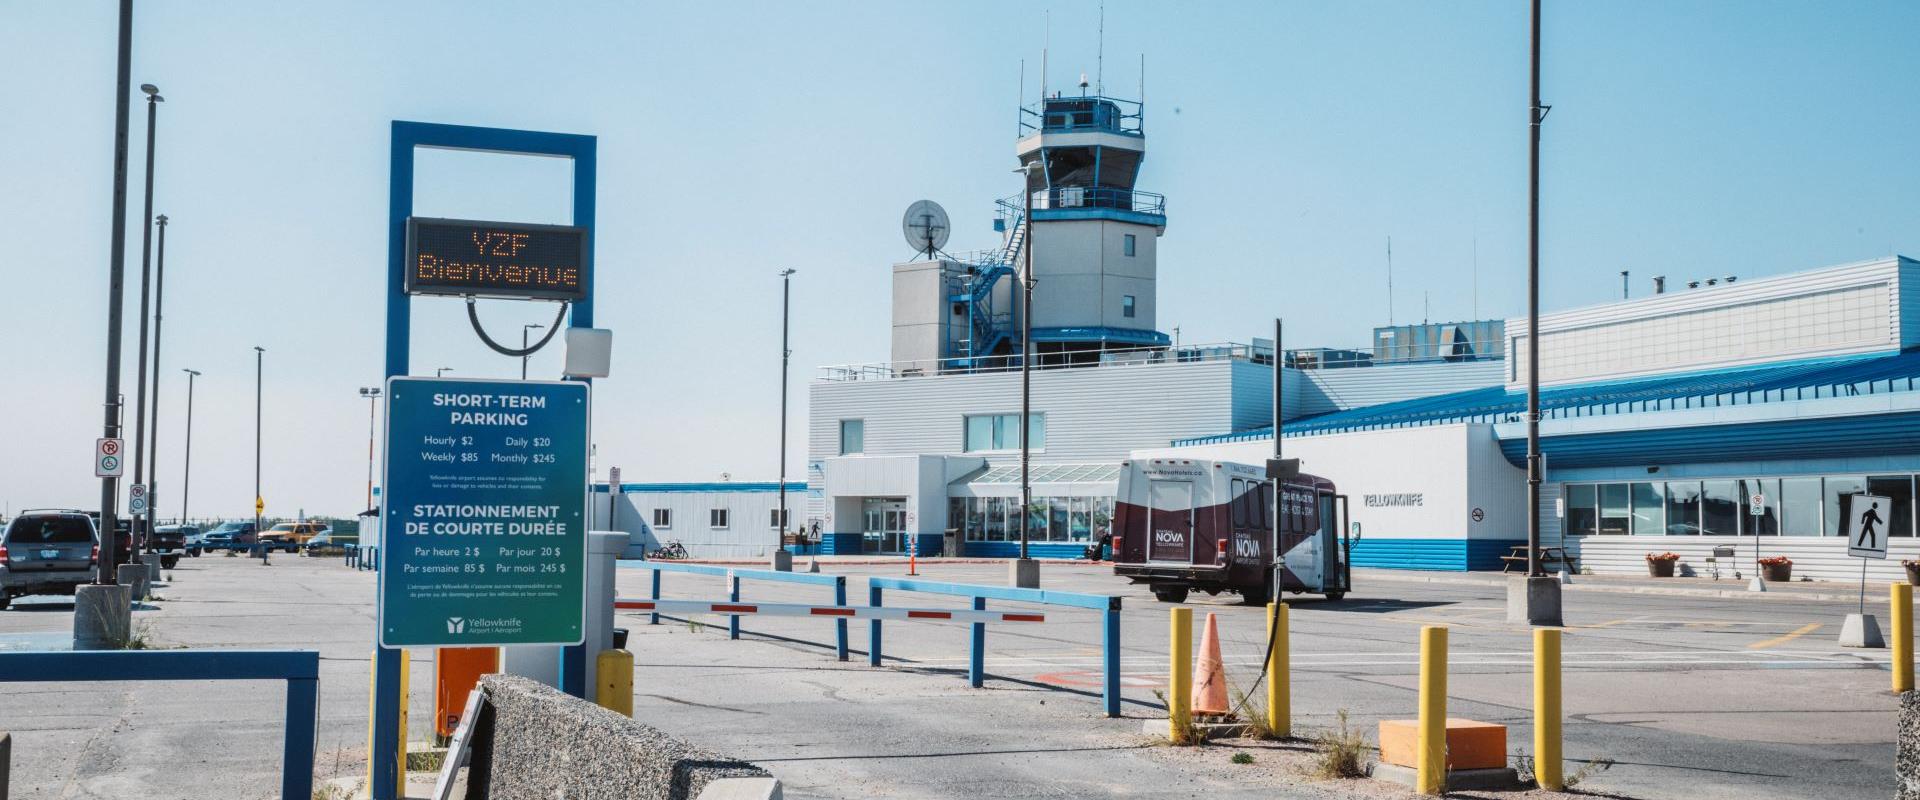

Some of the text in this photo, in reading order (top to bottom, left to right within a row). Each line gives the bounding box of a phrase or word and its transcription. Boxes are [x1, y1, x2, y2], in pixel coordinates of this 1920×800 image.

[473, 232, 529, 257] YZF
[418, 254, 577, 286] Bienvenue
[433, 393, 546, 408] SHORT-TERM
[451, 412, 528, 426] PARKING
[424, 435, 474, 448] Hourly $2
[505, 436, 551, 448] Daily $20
[421, 452, 478, 464] Weekly $85
[491, 452, 555, 464] Monthly $245
[1363, 493, 1423, 507] YELLOWKNIFE
[413, 504, 560, 518] STATIONNEMENT
[405, 519, 567, 535] DE COURTE DURÉE
[1156, 533, 1184, 542] NOVA
[415, 547, 480, 556] Par heure 2 $
[499, 547, 561, 558] Par jour 20 $
[1236, 539, 1260, 557] NOVA
[404, 564, 485, 573] Par semaine 85 $
[496, 563, 566, 573] Par mois 245 $
[468, 617, 522, 627] Yellowknife
